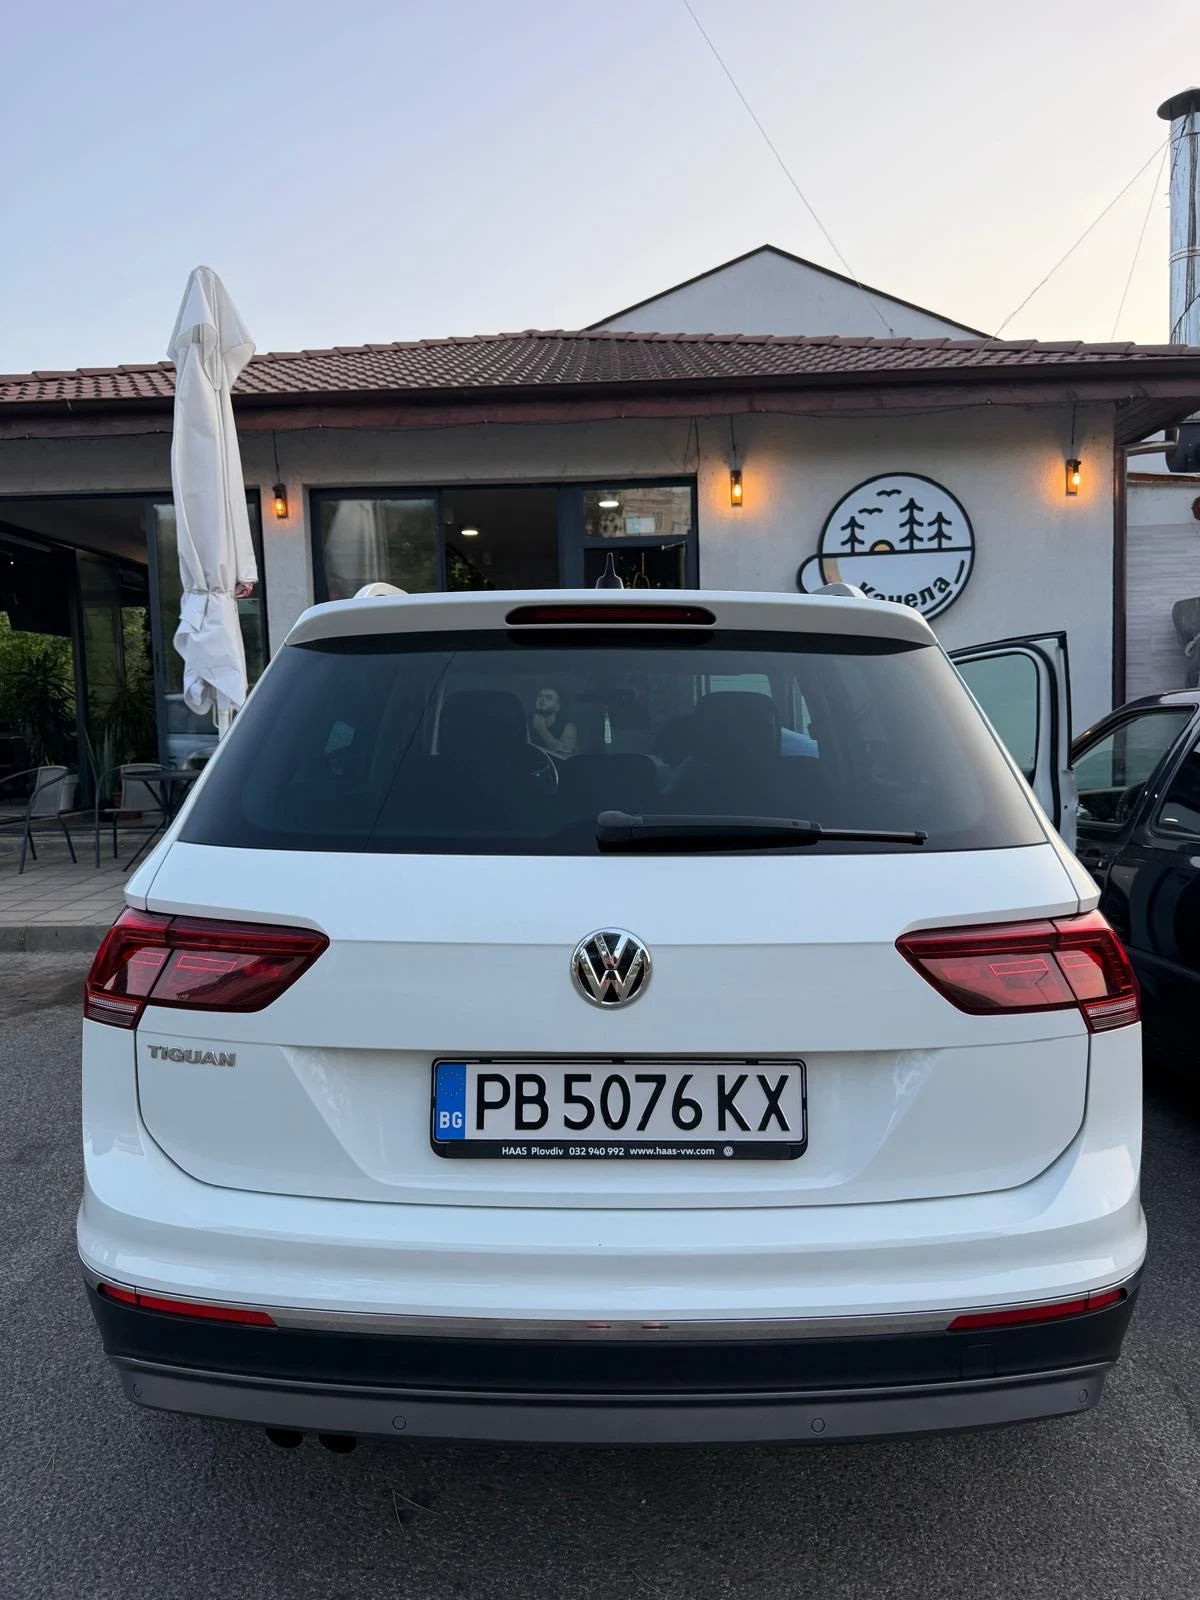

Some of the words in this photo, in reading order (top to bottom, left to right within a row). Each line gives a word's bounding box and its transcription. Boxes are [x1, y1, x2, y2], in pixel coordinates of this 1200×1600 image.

[147, 1044, 237, 1067] TIGUAN
[476, 1073, 549, 1131] PB
[563, 1073, 703, 1131] 5076
[716, 1074, 791, 1132] KX
[439, 1111, 463, 1129] BG
[501, 1146, 527, 1156] HAAS
[531, 1146, 564, 1156] Plovdiv
[568, 1146, 587, 1156] 032
[587, 1146, 606, 1156] 940
[607, 1146, 625, 1156] 992
[629, 1146, 715, 1156] www.haas-vw.com
